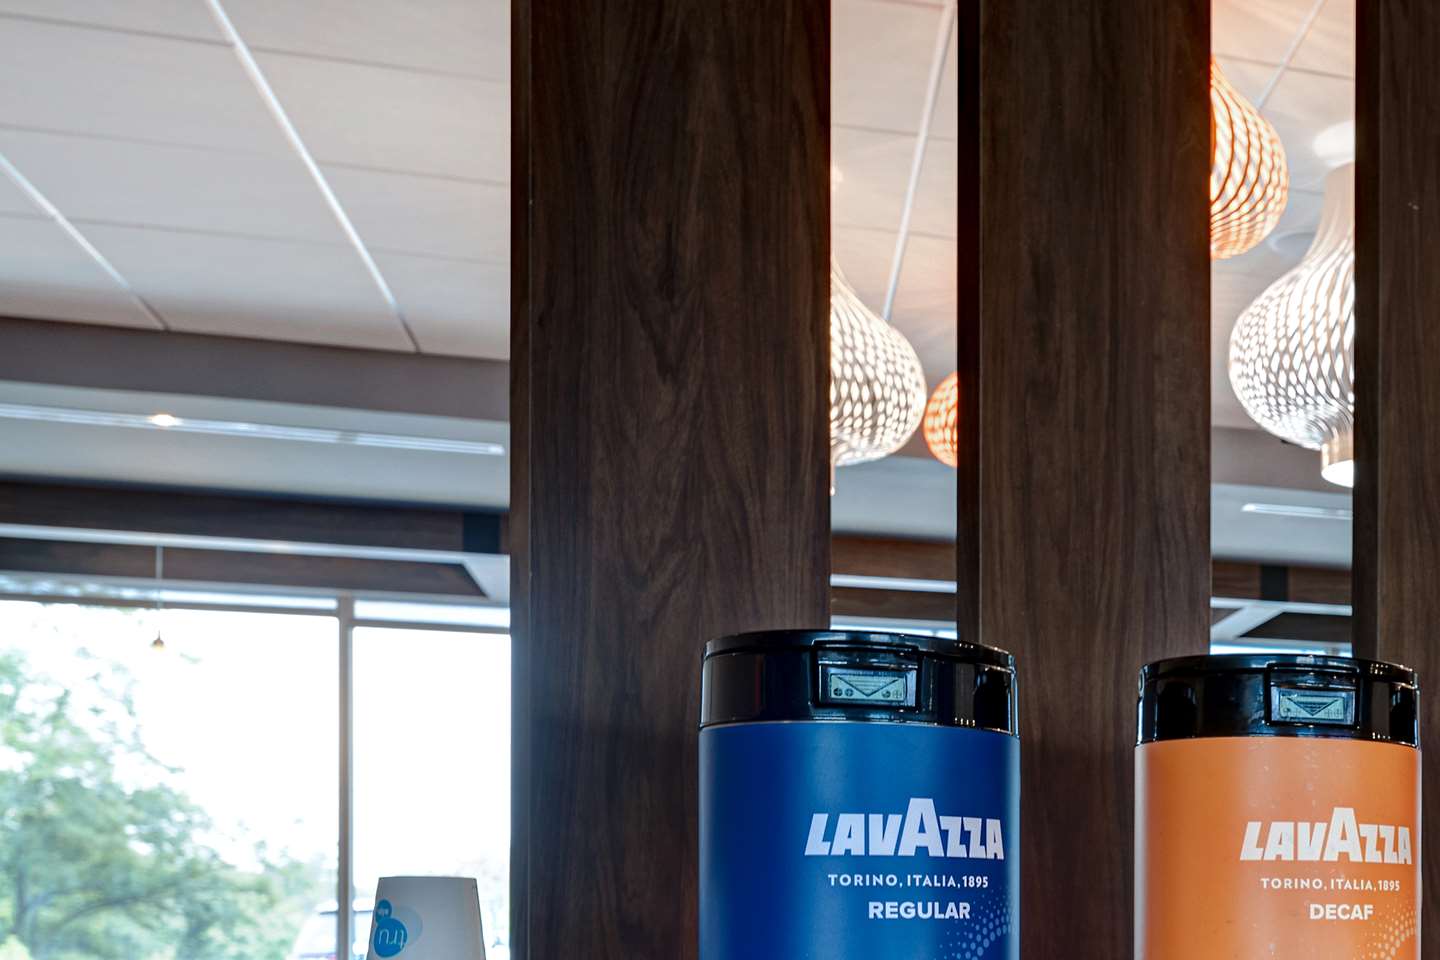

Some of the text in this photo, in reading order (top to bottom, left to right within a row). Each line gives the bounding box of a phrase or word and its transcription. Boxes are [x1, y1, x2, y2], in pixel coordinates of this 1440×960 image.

[804, 797, 1004, 860] LAVAZZA
[1240, 806, 1412, 865] LAVAZZA
[828, 874, 903, 888] TORINO,
[1260, 877, 1328, 890] TORINO,
[868, 901, 971, 920] REGULAR
[1309, 904, 1374, 921] DECAF
